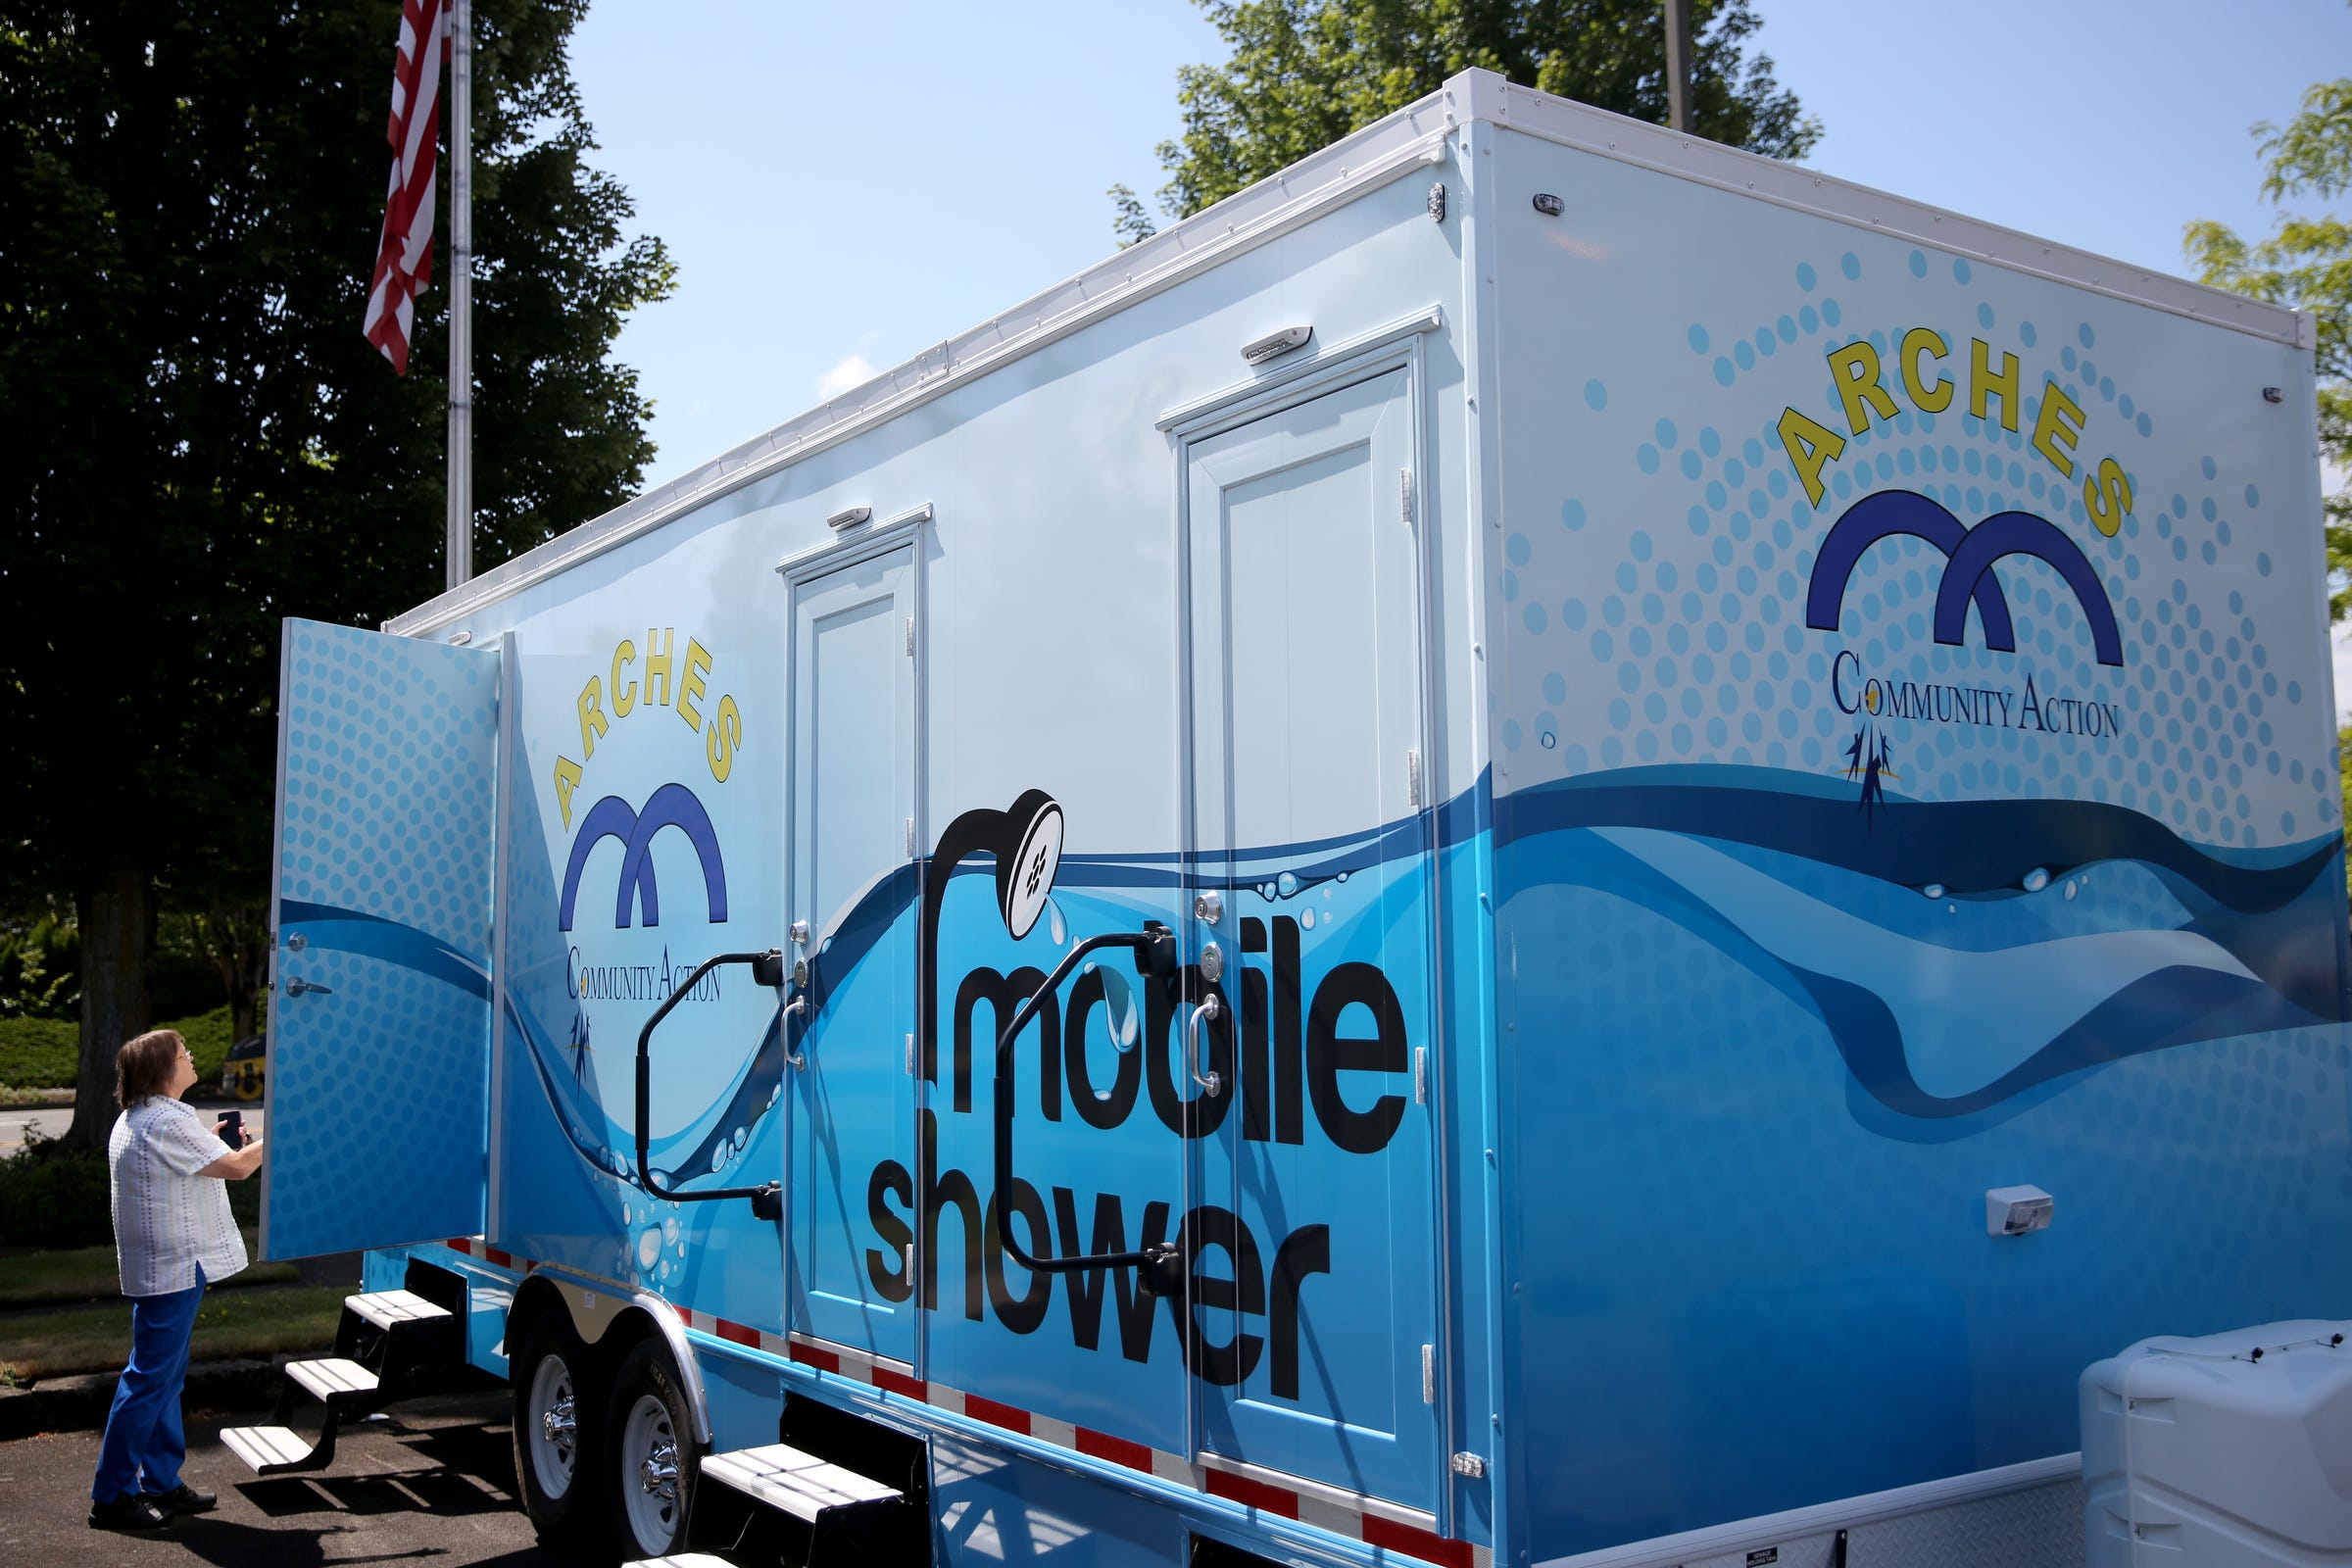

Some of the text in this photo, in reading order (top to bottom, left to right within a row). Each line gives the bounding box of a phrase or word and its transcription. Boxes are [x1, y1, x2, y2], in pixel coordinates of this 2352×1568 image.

[1776, 327, 2132, 538] ARCHES
[553, 627, 742, 832] ARCHES
[1832, 650, 2120, 738] COMMUNITY ACTION
[566, 945, 656, 1001] COMMUNITY
[954, 914, 1409, 1154] mobile
[866, 1107, 1331, 1401] shower
